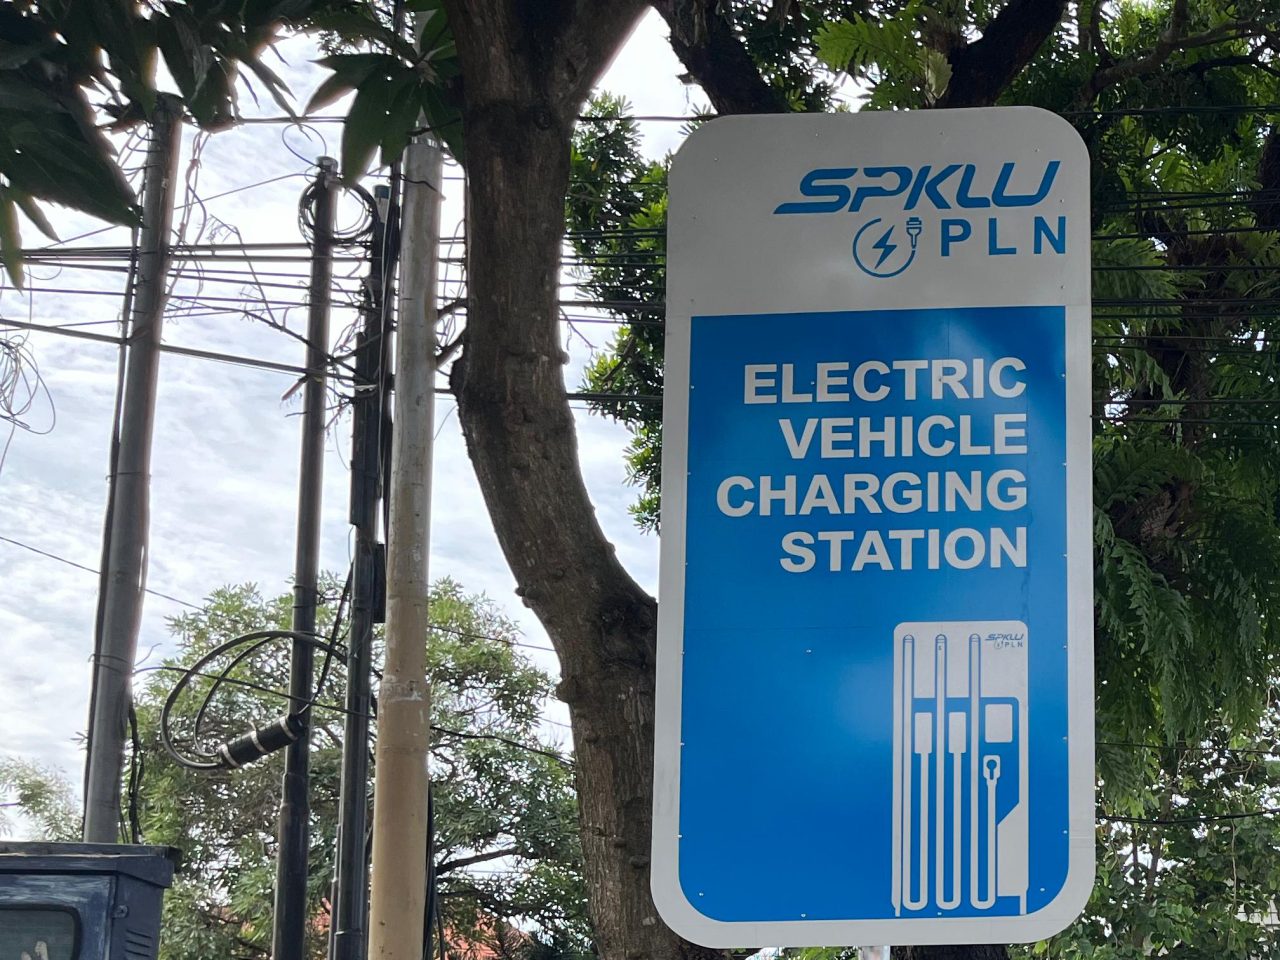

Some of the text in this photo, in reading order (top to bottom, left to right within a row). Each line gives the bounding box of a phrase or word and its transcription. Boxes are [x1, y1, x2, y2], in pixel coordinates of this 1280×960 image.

[773, 160, 1061, 214] SPKLU
[940, 216, 1066, 257] PLN
[743, 356, 1028, 405] ELECTRIC
[779, 413, 1028, 459] VEHICLE
[716, 469, 1028, 517] CHARGING
[779, 526, 1028, 573] STATION
[985, 633, 1024, 641] SPKLU
